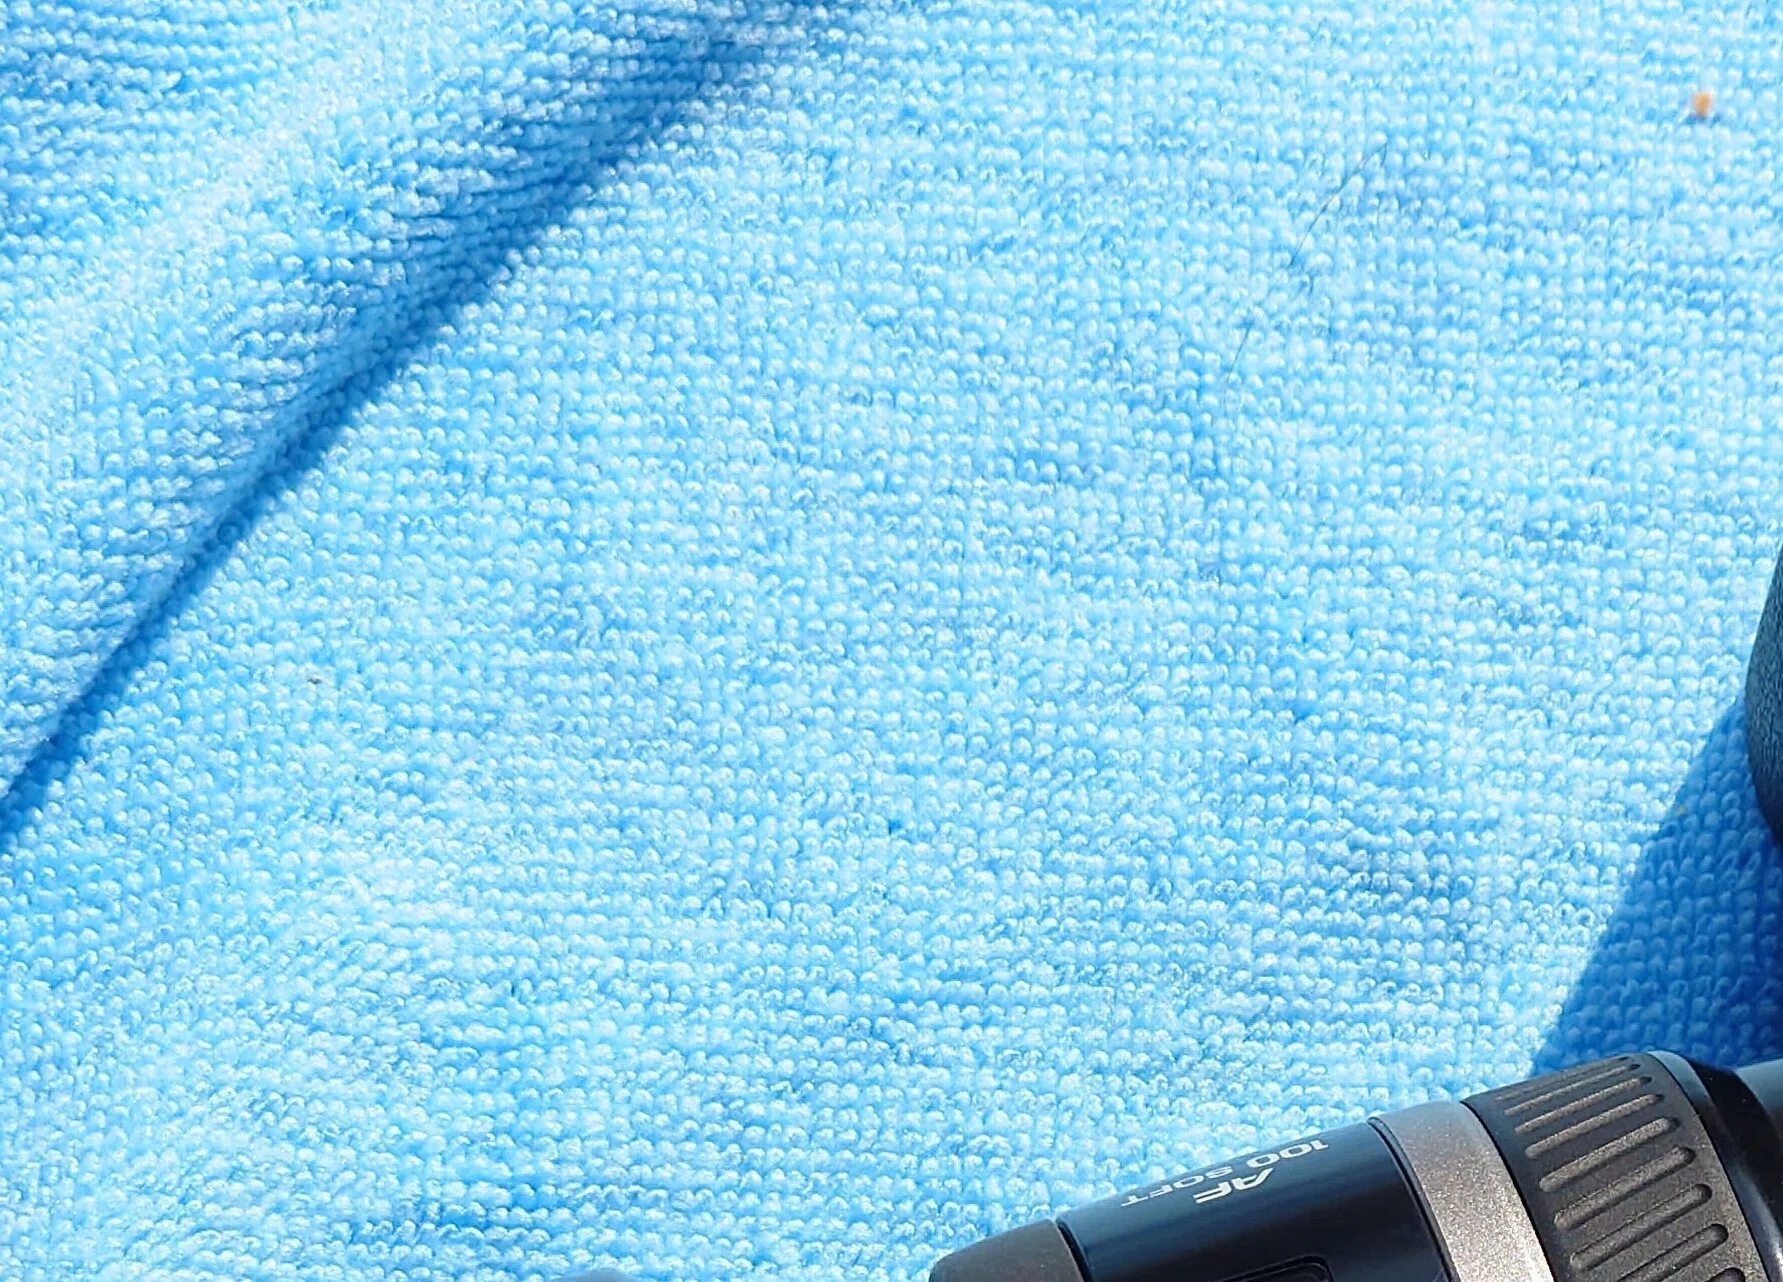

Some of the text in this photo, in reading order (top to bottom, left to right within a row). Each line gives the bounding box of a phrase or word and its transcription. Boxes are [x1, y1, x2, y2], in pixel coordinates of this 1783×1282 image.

[1120, 1139, 1329, 1207] 100 SOFT
[1192, 1167, 1274, 1204] AF
